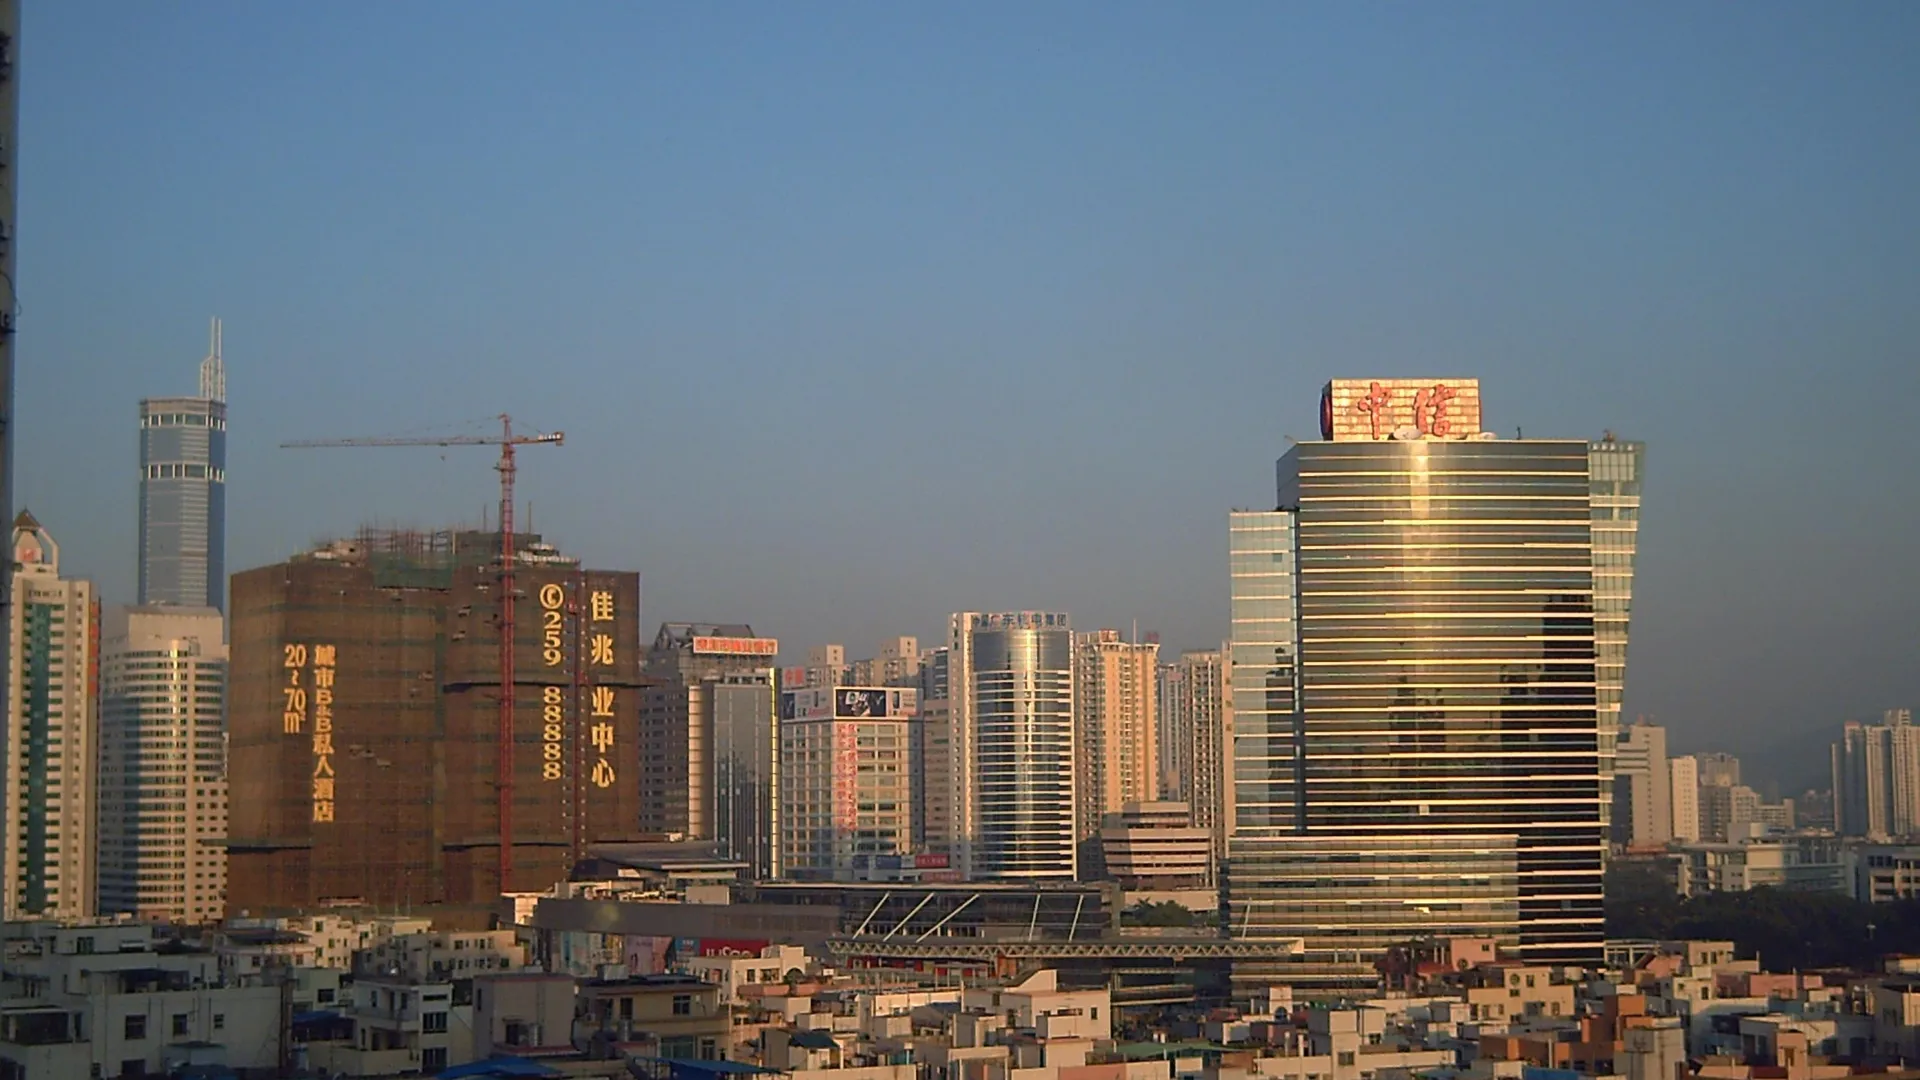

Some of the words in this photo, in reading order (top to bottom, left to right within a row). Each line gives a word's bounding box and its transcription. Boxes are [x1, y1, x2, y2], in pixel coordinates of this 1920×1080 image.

[1357, 381, 1457, 440] 中信
[591, 591, 616, 788] 佳兆业中心
